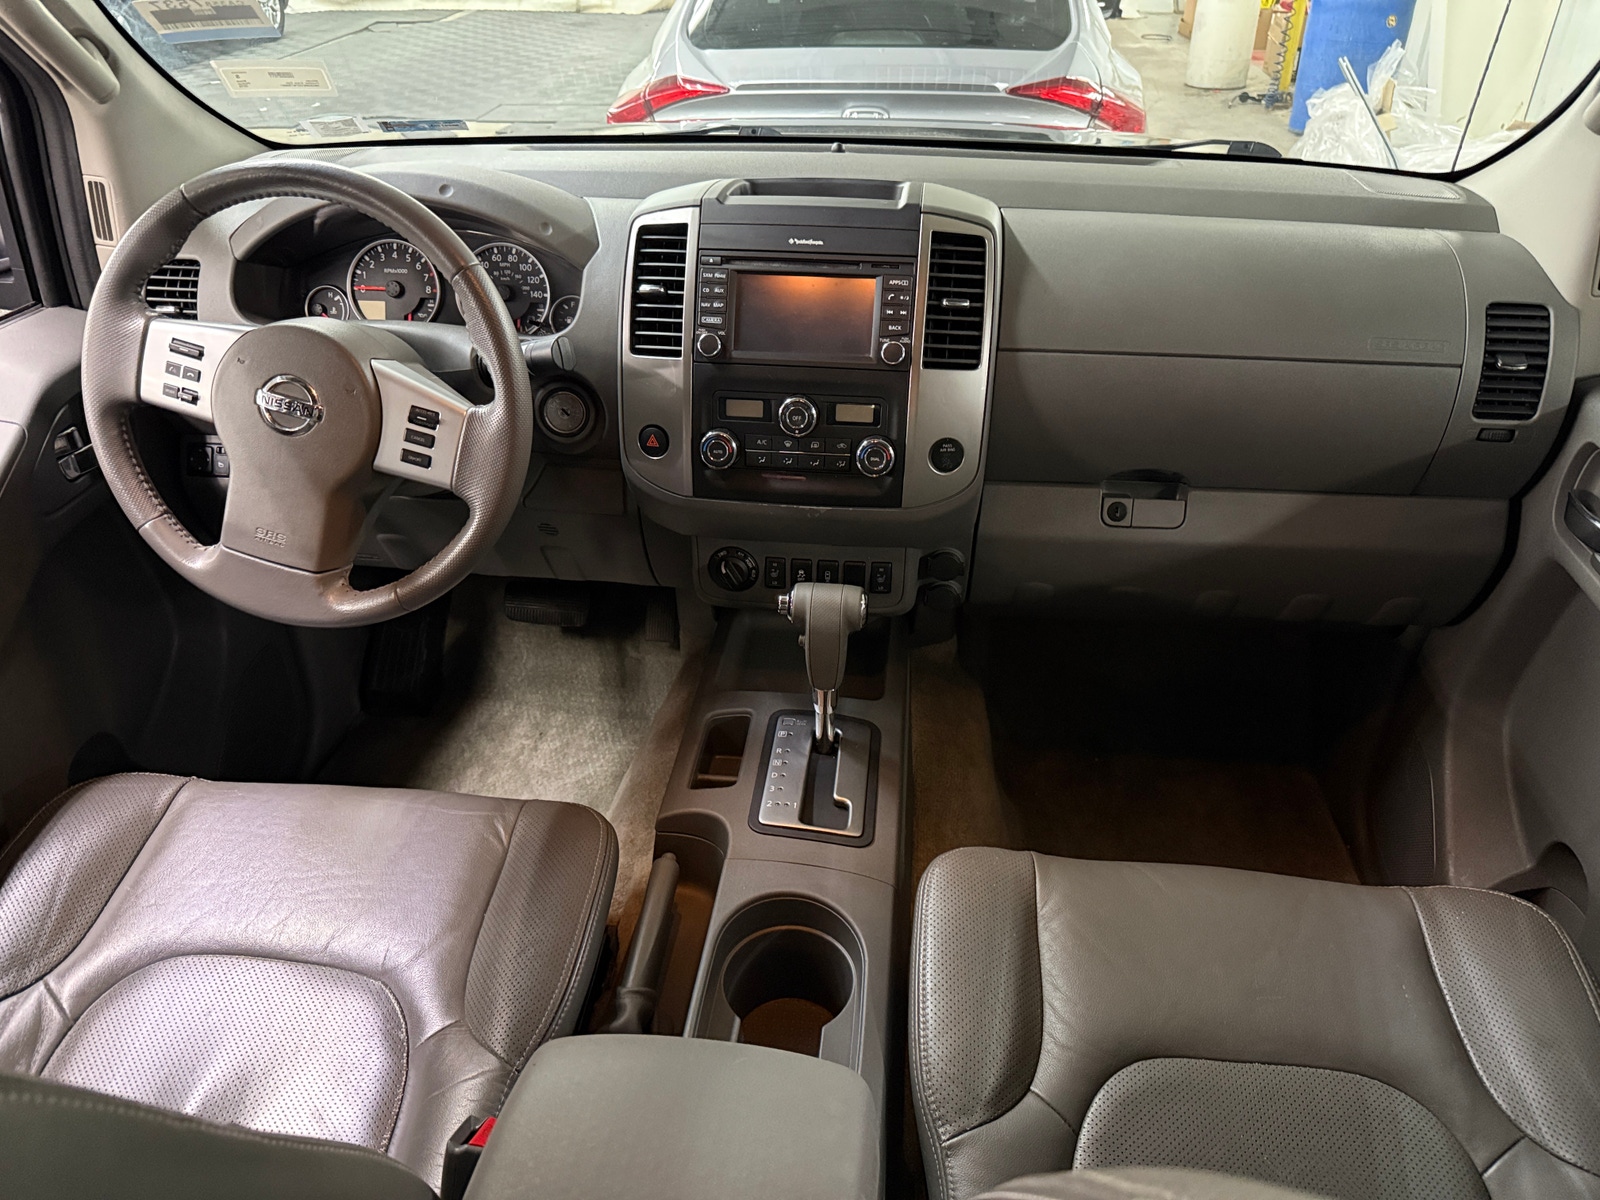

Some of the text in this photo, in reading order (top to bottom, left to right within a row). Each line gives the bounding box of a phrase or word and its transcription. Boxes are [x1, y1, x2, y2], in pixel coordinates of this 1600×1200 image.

[380, 253, 386, 262] 3
[391, 251, 398, 259] 4
[405, 254, 411, 262] 5
[491, 254, 502, 262] 60
[507, 254, 518, 262] 80
[369, 261, 375, 269] 2
[415, 262, 422, 270] 6
[519, 263, 533, 271] 100
[362, 271, 367, 280] 1
[423, 273, 429, 281] 7
[527, 276, 540, 284] 120
[425, 285, 432, 294] 8
[530, 290, 543, 299] 140
[261, 393, 314, 419] NISSAN
